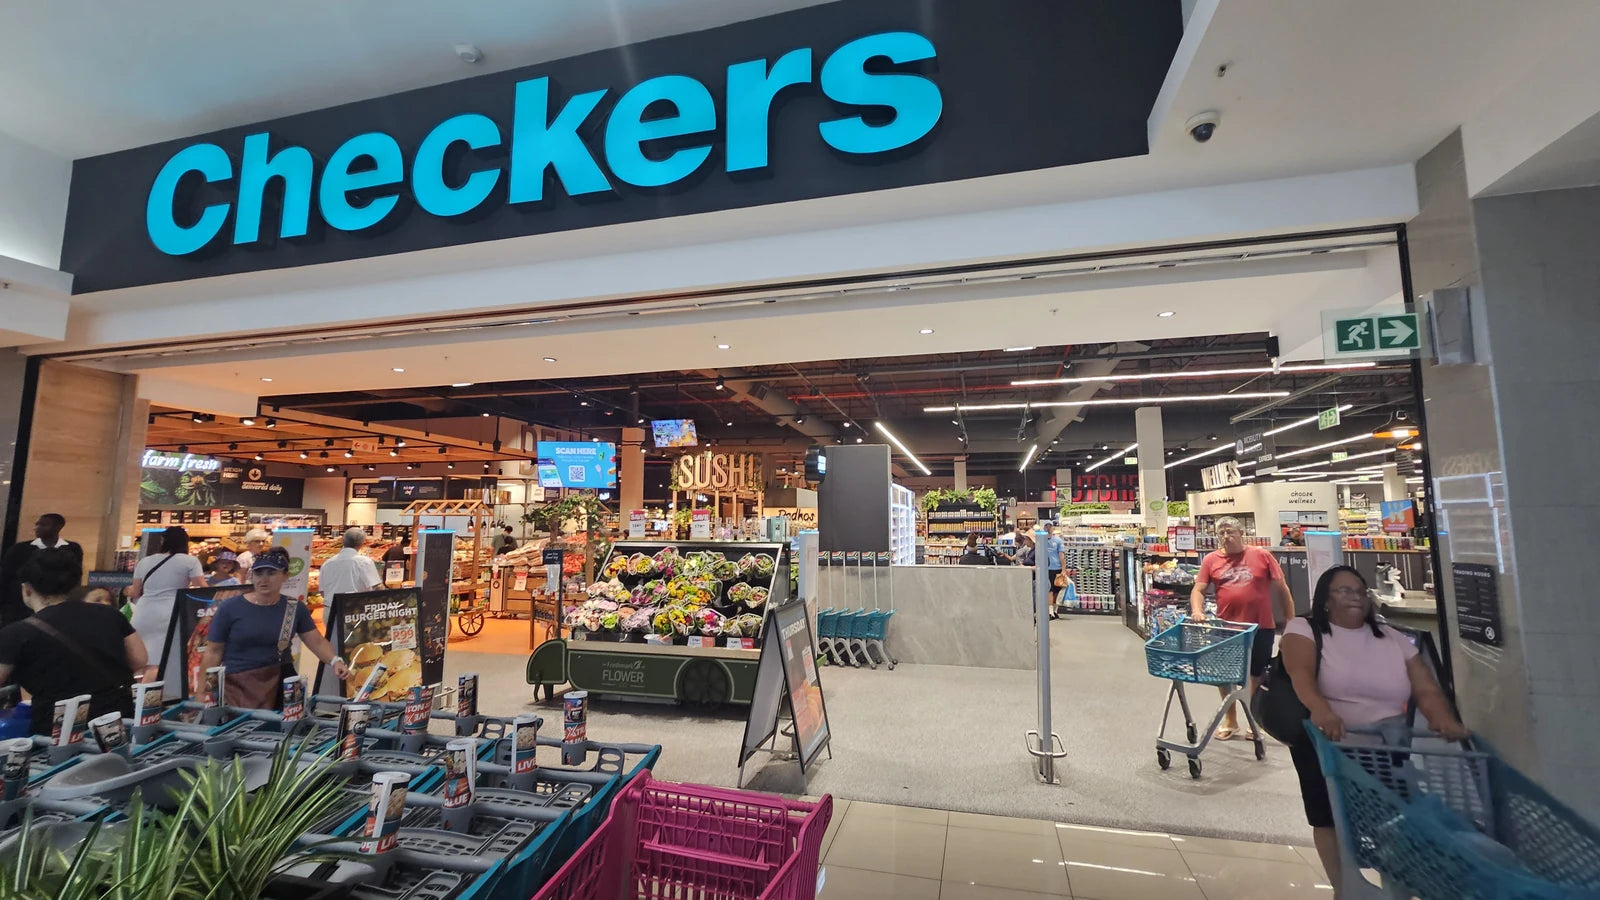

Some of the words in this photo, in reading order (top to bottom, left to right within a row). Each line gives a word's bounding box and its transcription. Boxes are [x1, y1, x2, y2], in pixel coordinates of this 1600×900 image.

[146, 30, 943, 256] Checkers
[556, 447, 576, 455] SCAN
[577, 447, 597, 455] HERE
[141, 449, 179, 468] farm
[179, 453, 219, 472] fresh
[1200, 459, 1242, 491] WELLNESS
[269, 484, 283, 495] daily
[344, 611, 386, 624] BURGER
[388, 607, 418, 618] NIGHT
[364, 601, 400, 613] FRIDAY
[781, 618, 806, 640] THURSDAY
[602, 669, 644, 682] FLOWER
